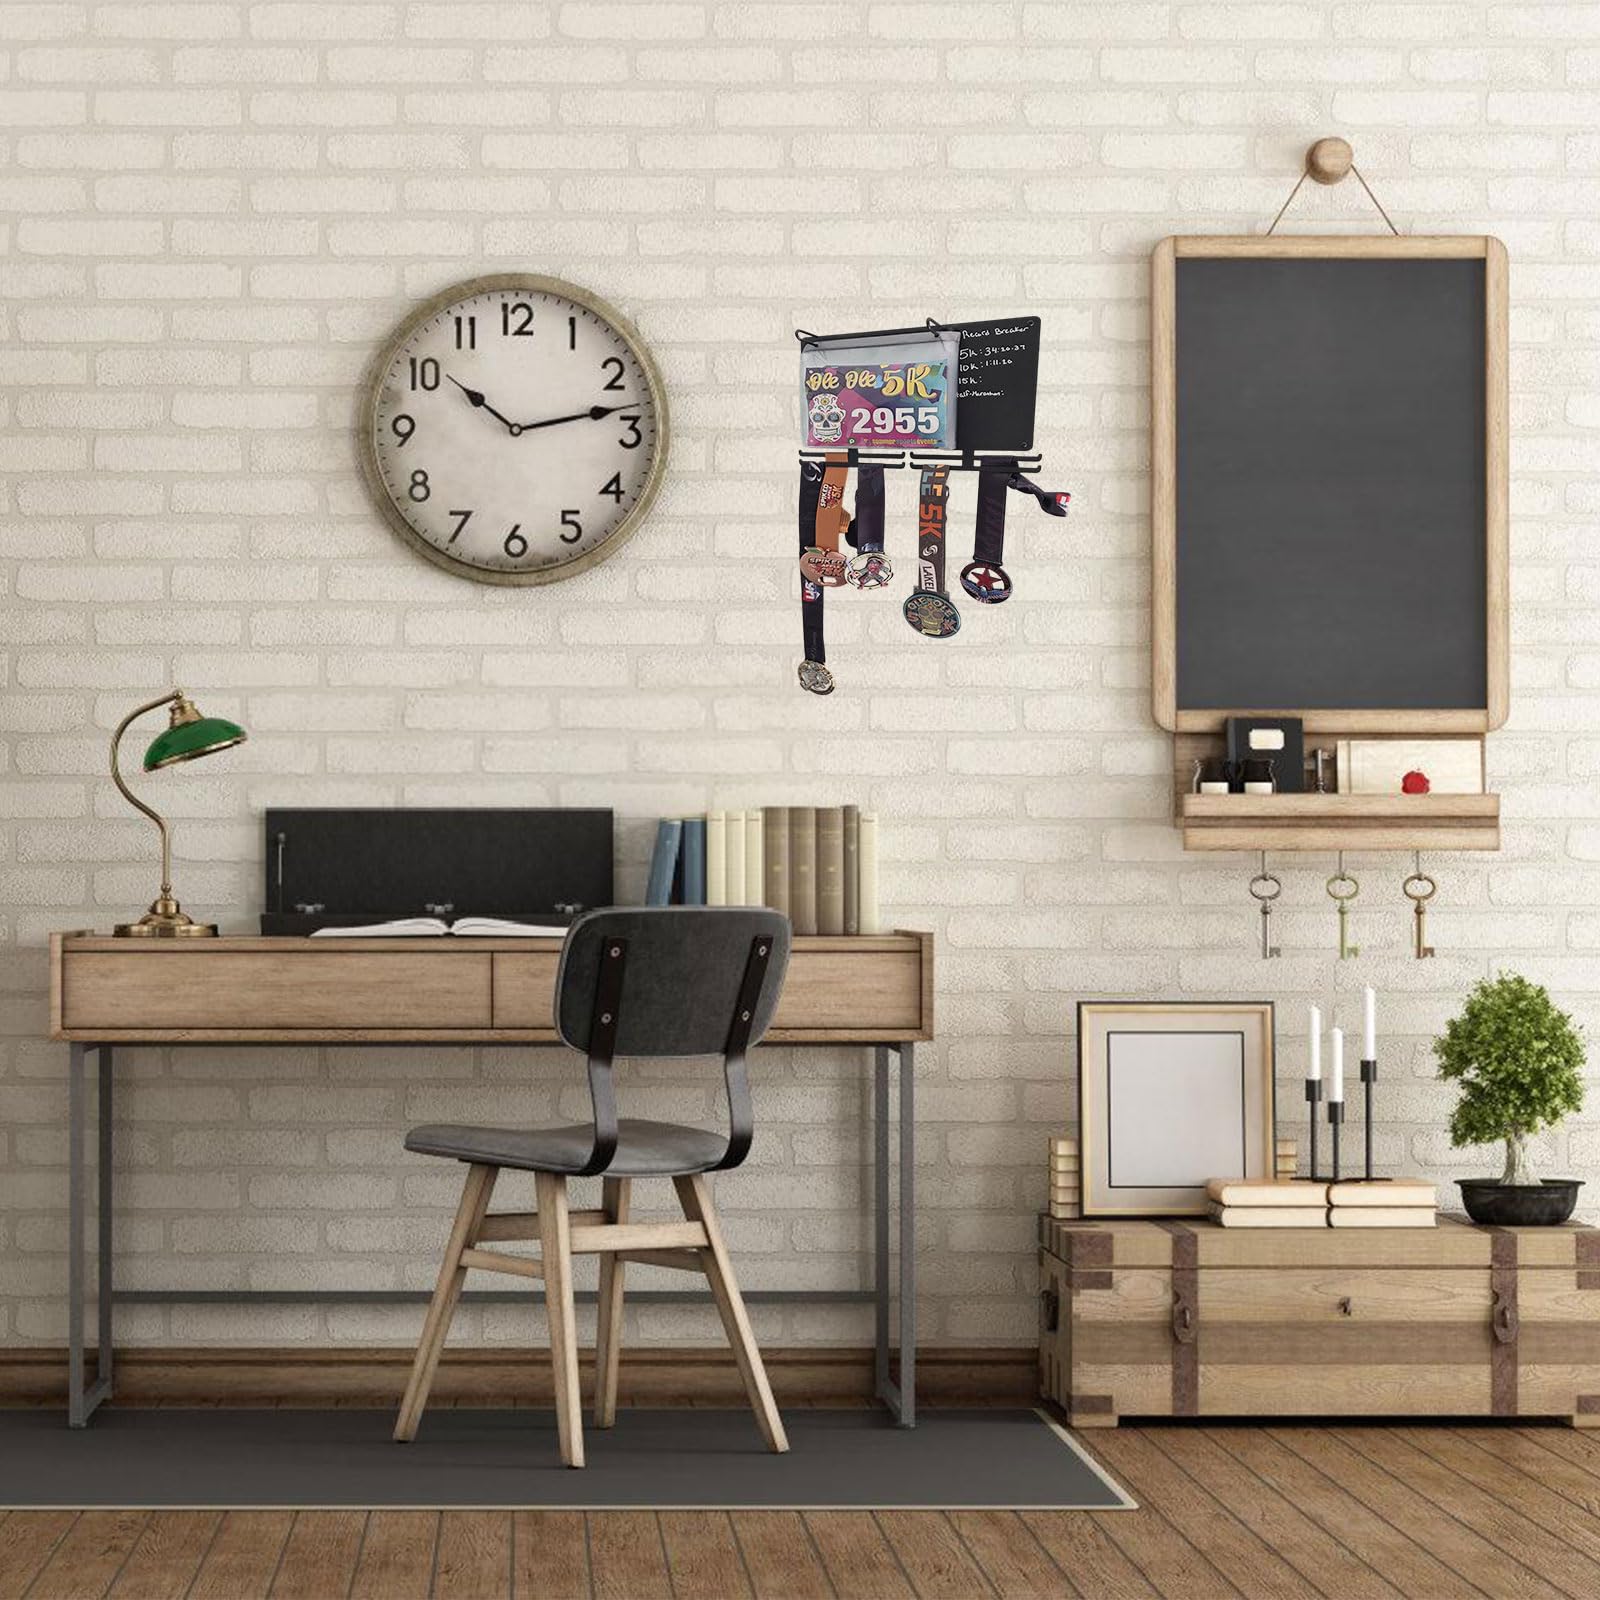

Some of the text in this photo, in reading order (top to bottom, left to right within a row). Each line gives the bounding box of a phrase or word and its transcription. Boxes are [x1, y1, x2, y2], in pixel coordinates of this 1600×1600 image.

[455, 316, 476, 350] 11
[502, 303, 534, 336] 12
[569, 316, 576, 350] 1
[995, 326, 1029, 336] Breaker
[409, 357, 440, 391] 10
[601, 357, 625, 391] 2
[806, 364, 938, 399] Ole Ole 5K
[392, 414, 416, 447] 9
[618, 415, 642, 449] 3
[851, 406, 940, 434] 2955
[409, 469, 430, 503] 8
[598, 471, 625, 503] 4
[820, 483, 829, 508] SPIKED
[831, 484, 842, 500] 5K
[449, 510, 473, 543] 7
[559, 509, 582, 544] 5
[919, 503, 943, 538] 5K
[504, 524, 528, 558] 6
